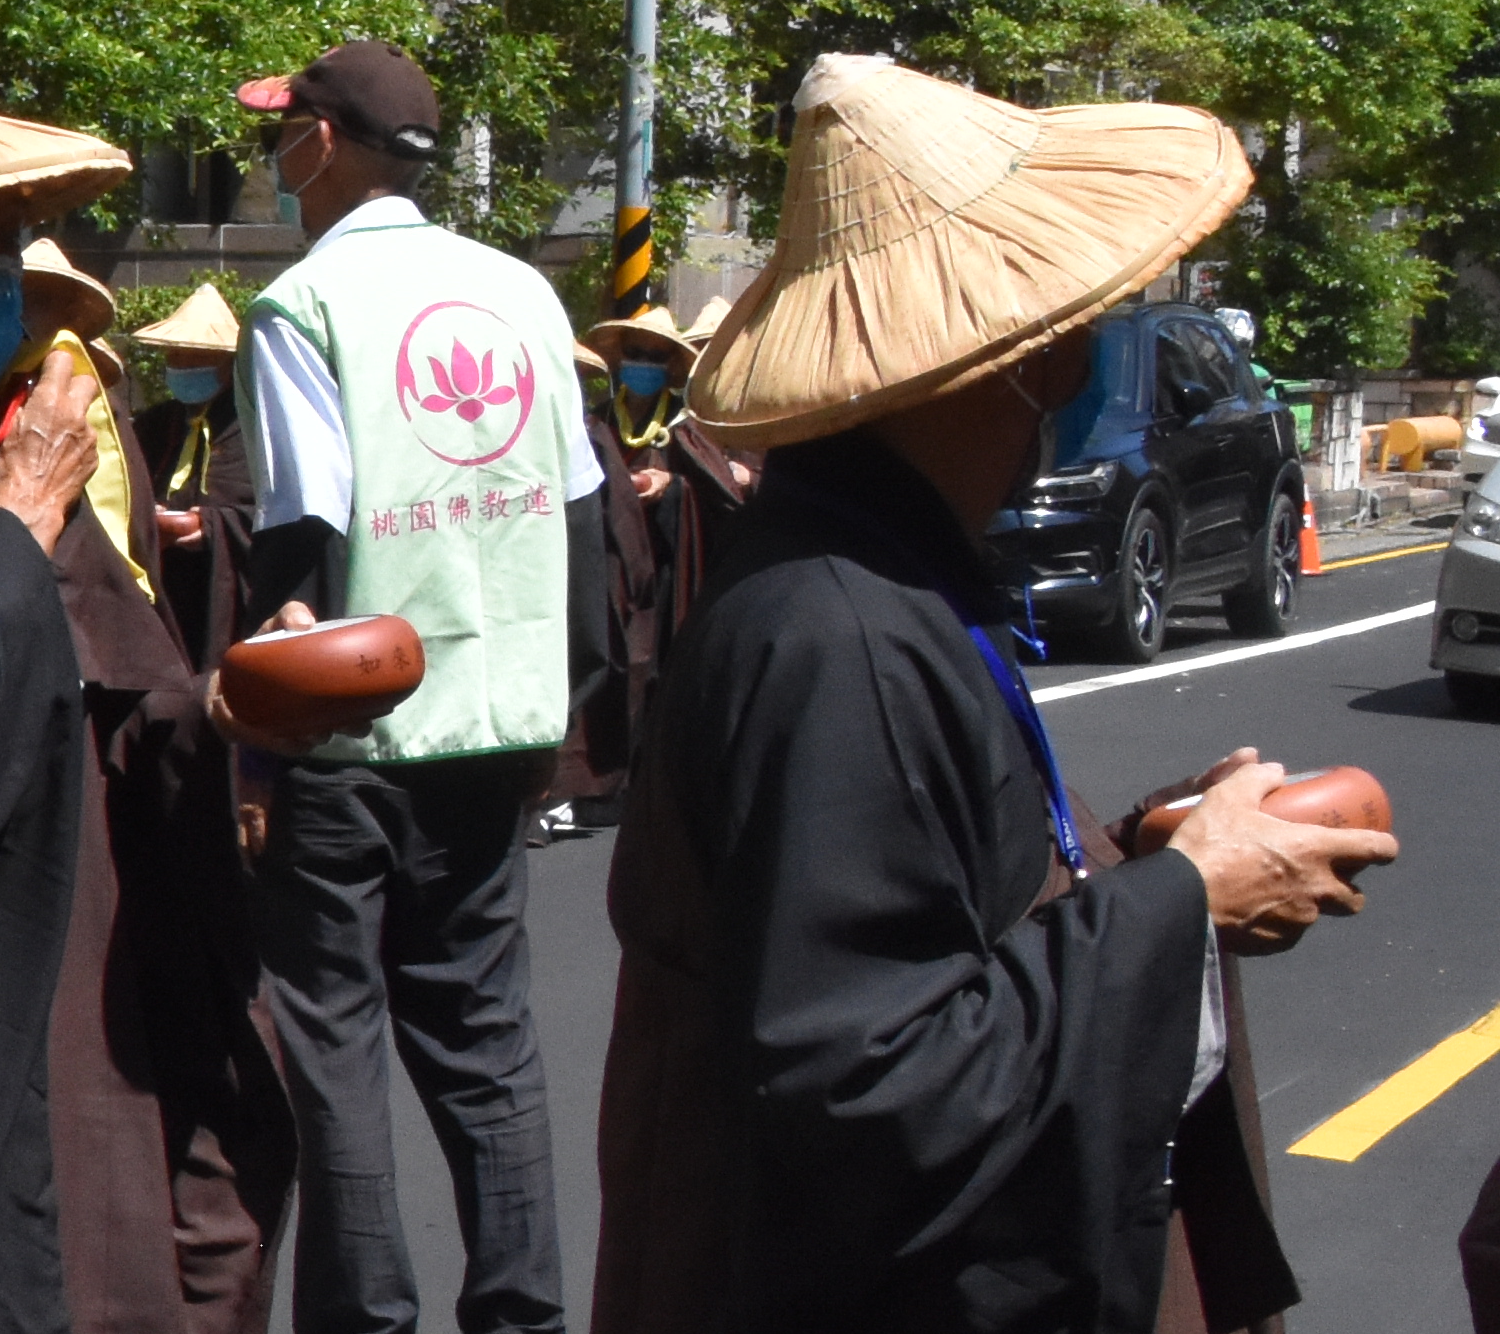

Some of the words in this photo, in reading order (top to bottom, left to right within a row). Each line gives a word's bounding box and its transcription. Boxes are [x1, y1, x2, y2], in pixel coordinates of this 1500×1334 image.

[370, 483, 553, 541] 桃園佛教蓮
